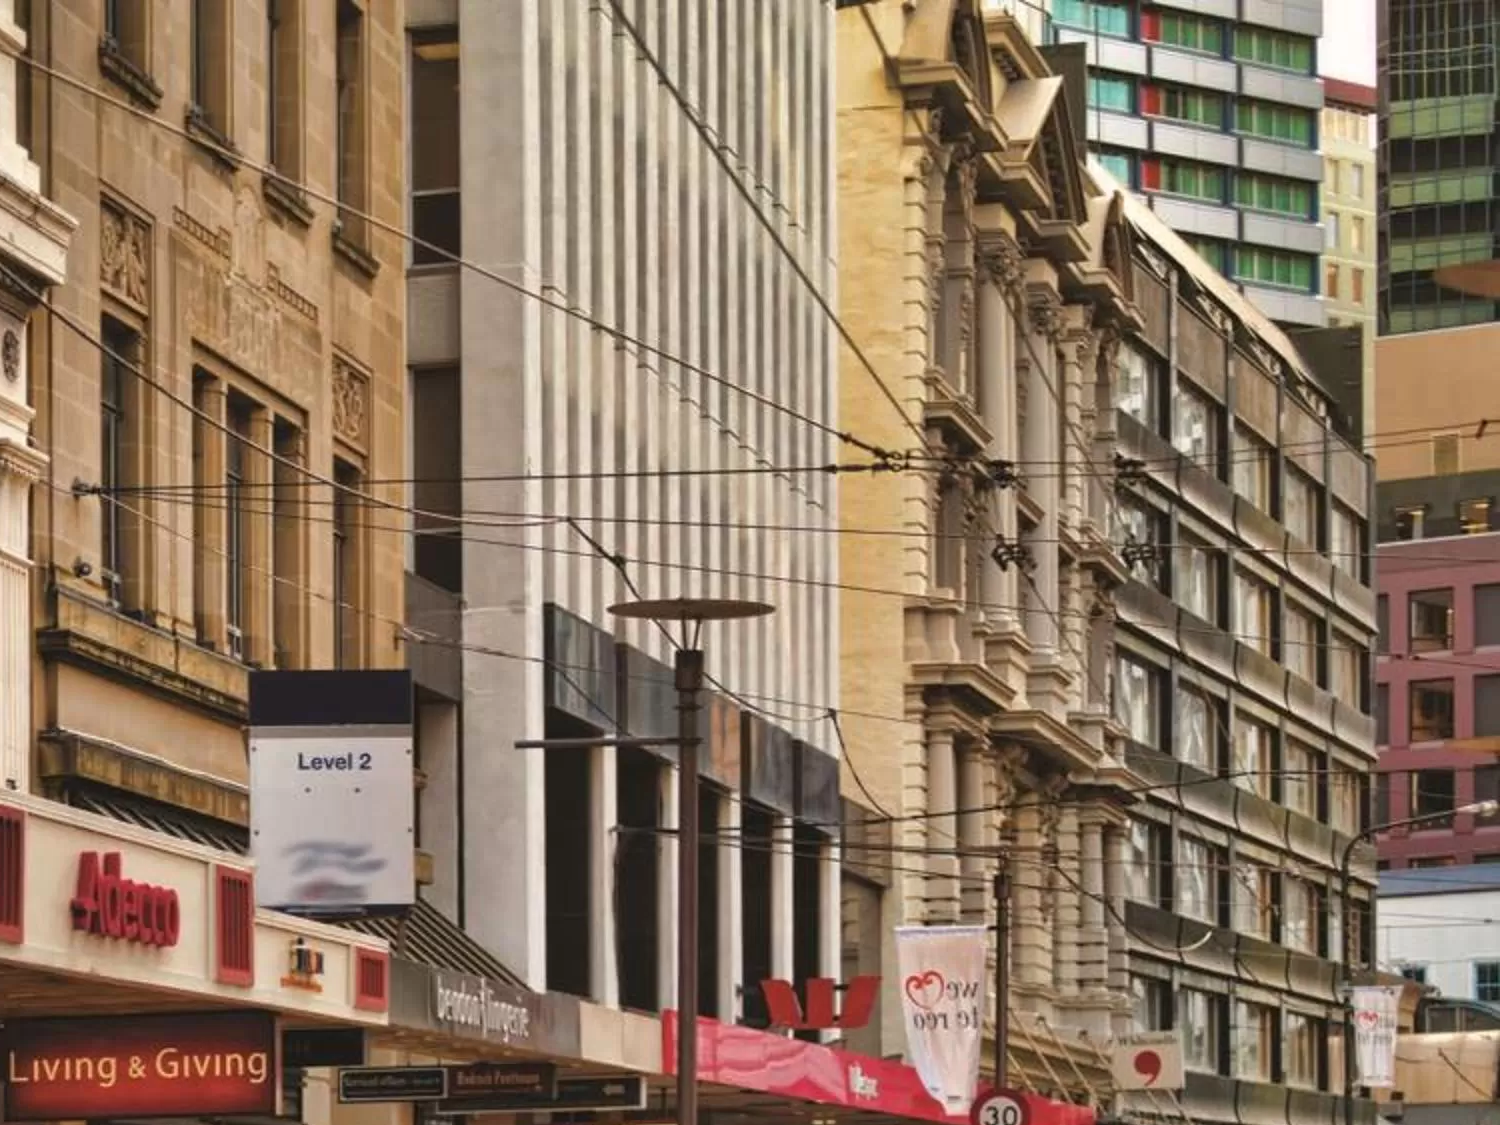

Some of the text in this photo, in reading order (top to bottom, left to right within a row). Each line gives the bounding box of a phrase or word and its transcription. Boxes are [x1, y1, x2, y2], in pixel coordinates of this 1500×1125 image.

[297, 752, 373, 771] Level 2
[69, 851, 180, 947] Adecco
[8, 1047, 268, 1088] Living & Giving
